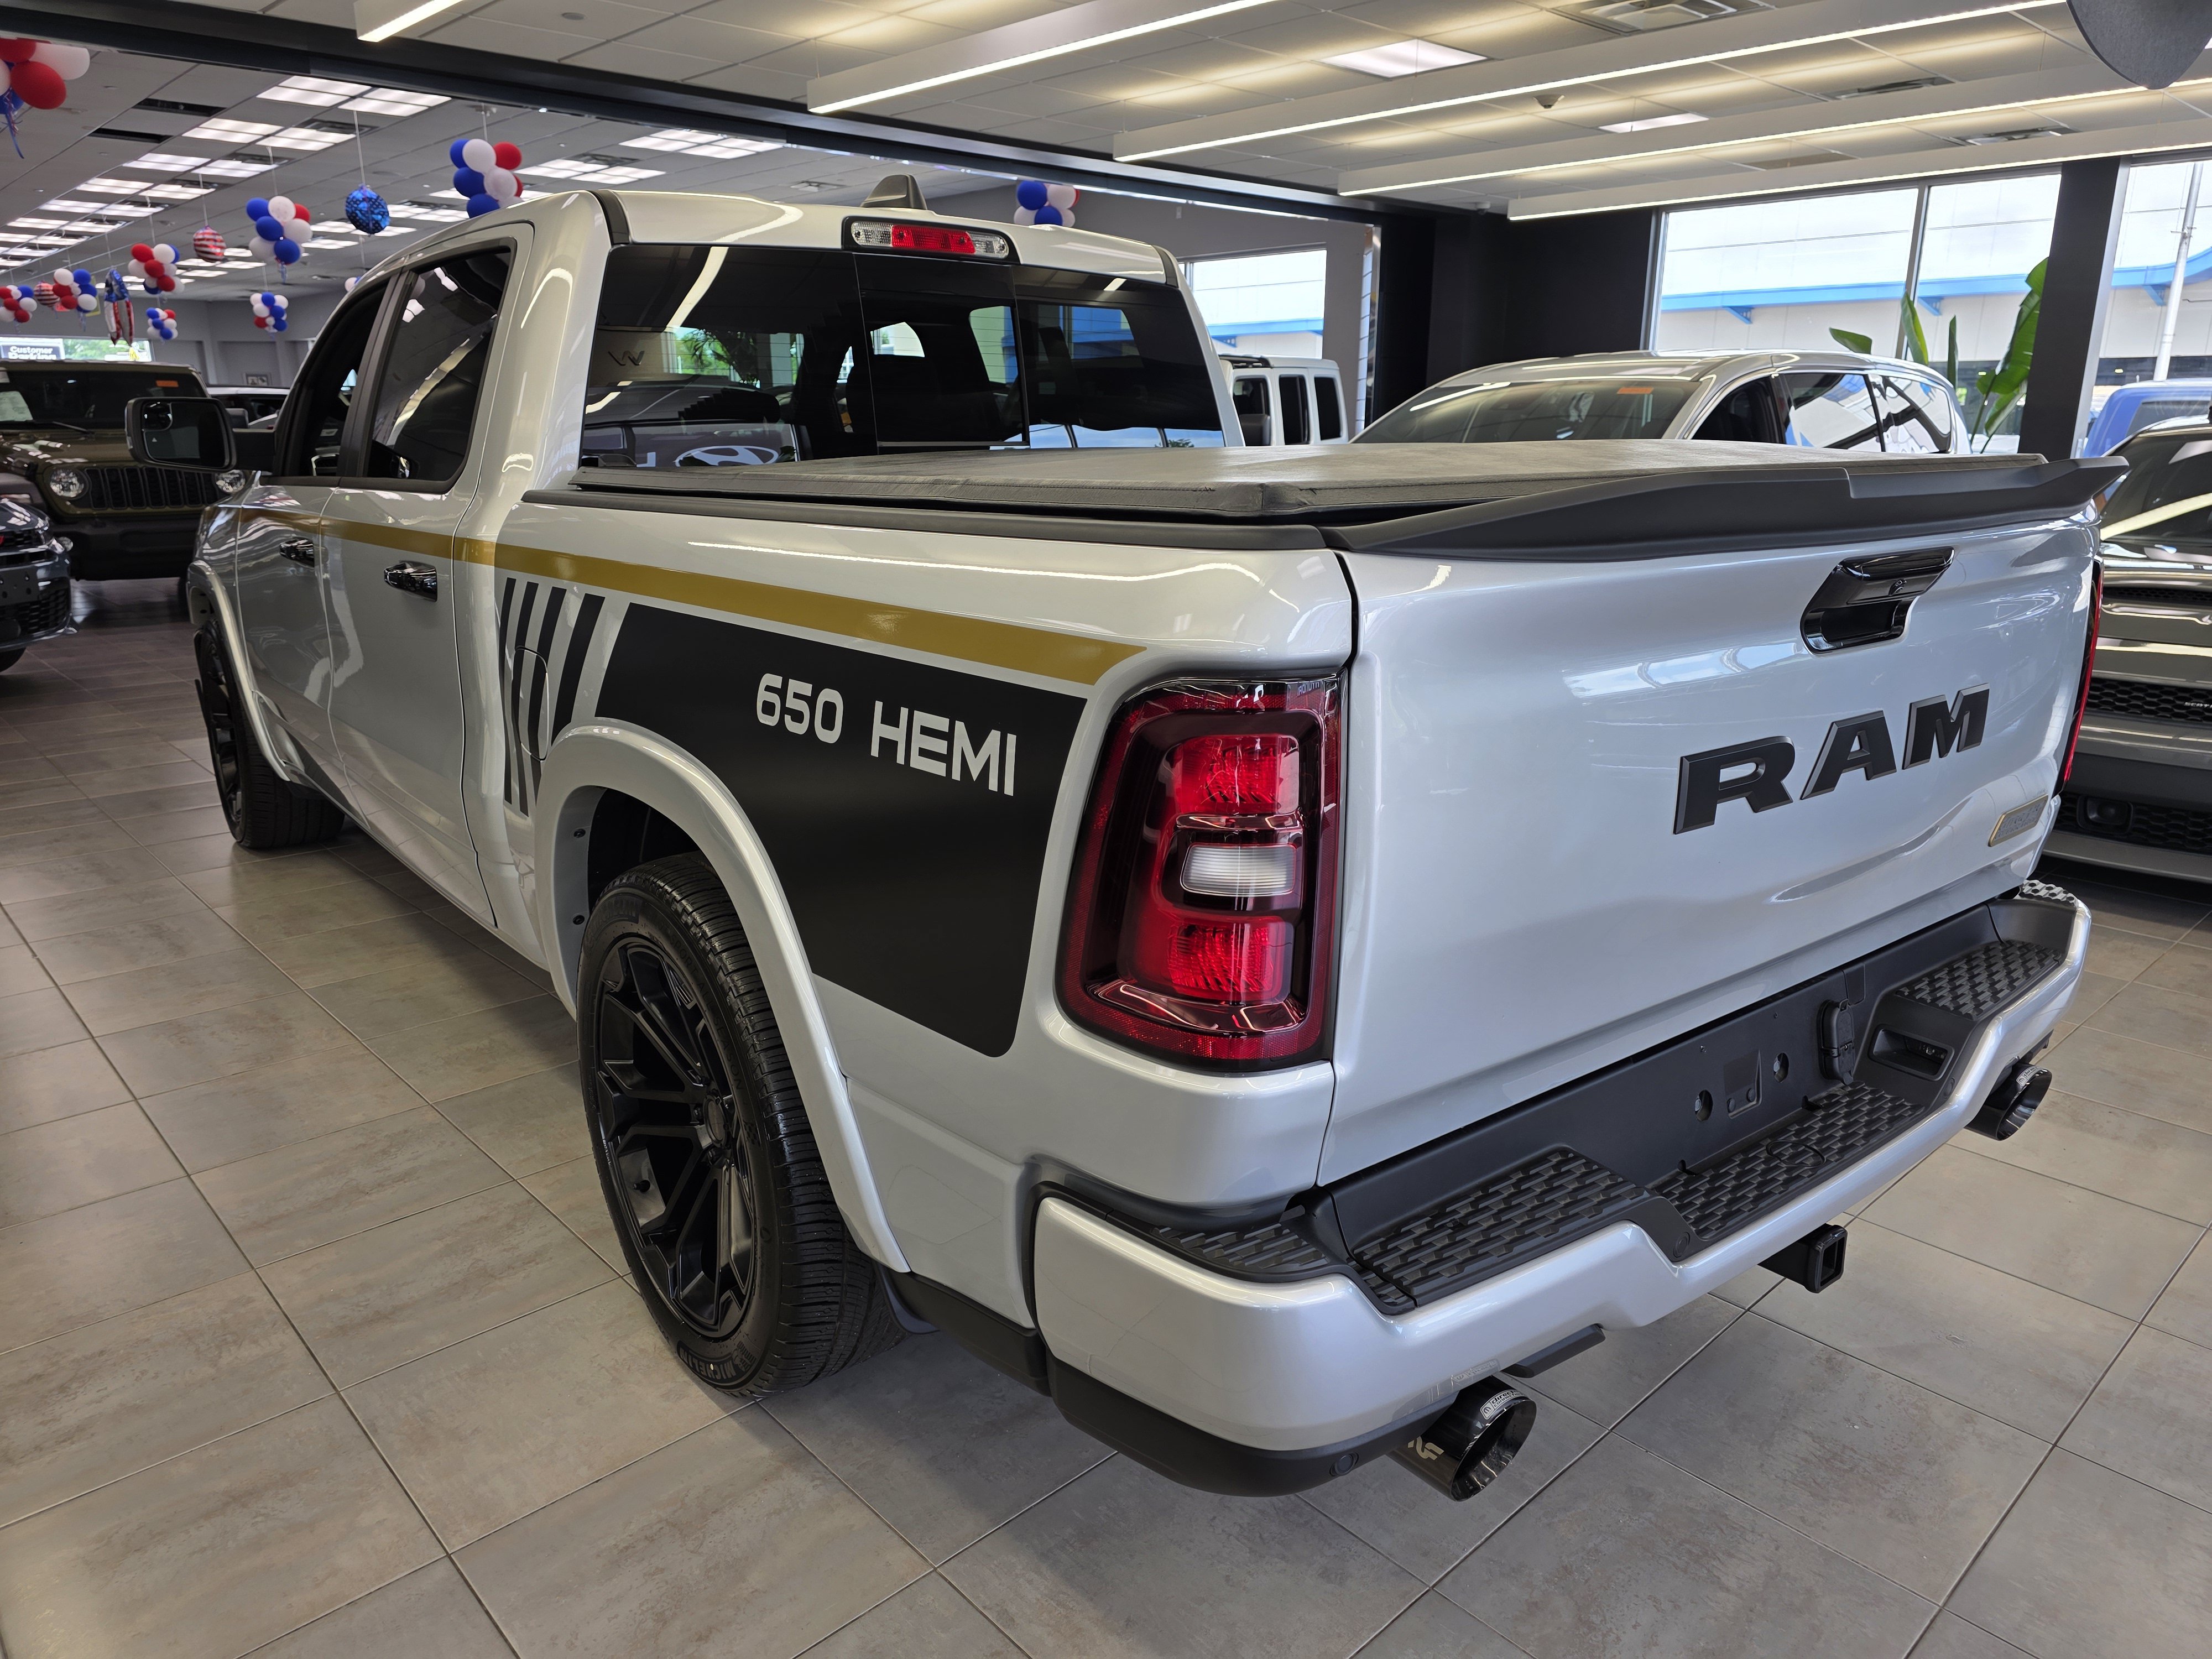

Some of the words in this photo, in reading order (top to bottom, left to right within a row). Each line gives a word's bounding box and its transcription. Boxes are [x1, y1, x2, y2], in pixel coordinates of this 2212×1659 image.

[10, 346, 53, 354] Customer
[757, 673, 844, 744] 650
[870, 700, 1017, 796] HEMI
[1673, 682, 1990, 835] RAM
[679, 1347, 737, 1380] MICHELIN
